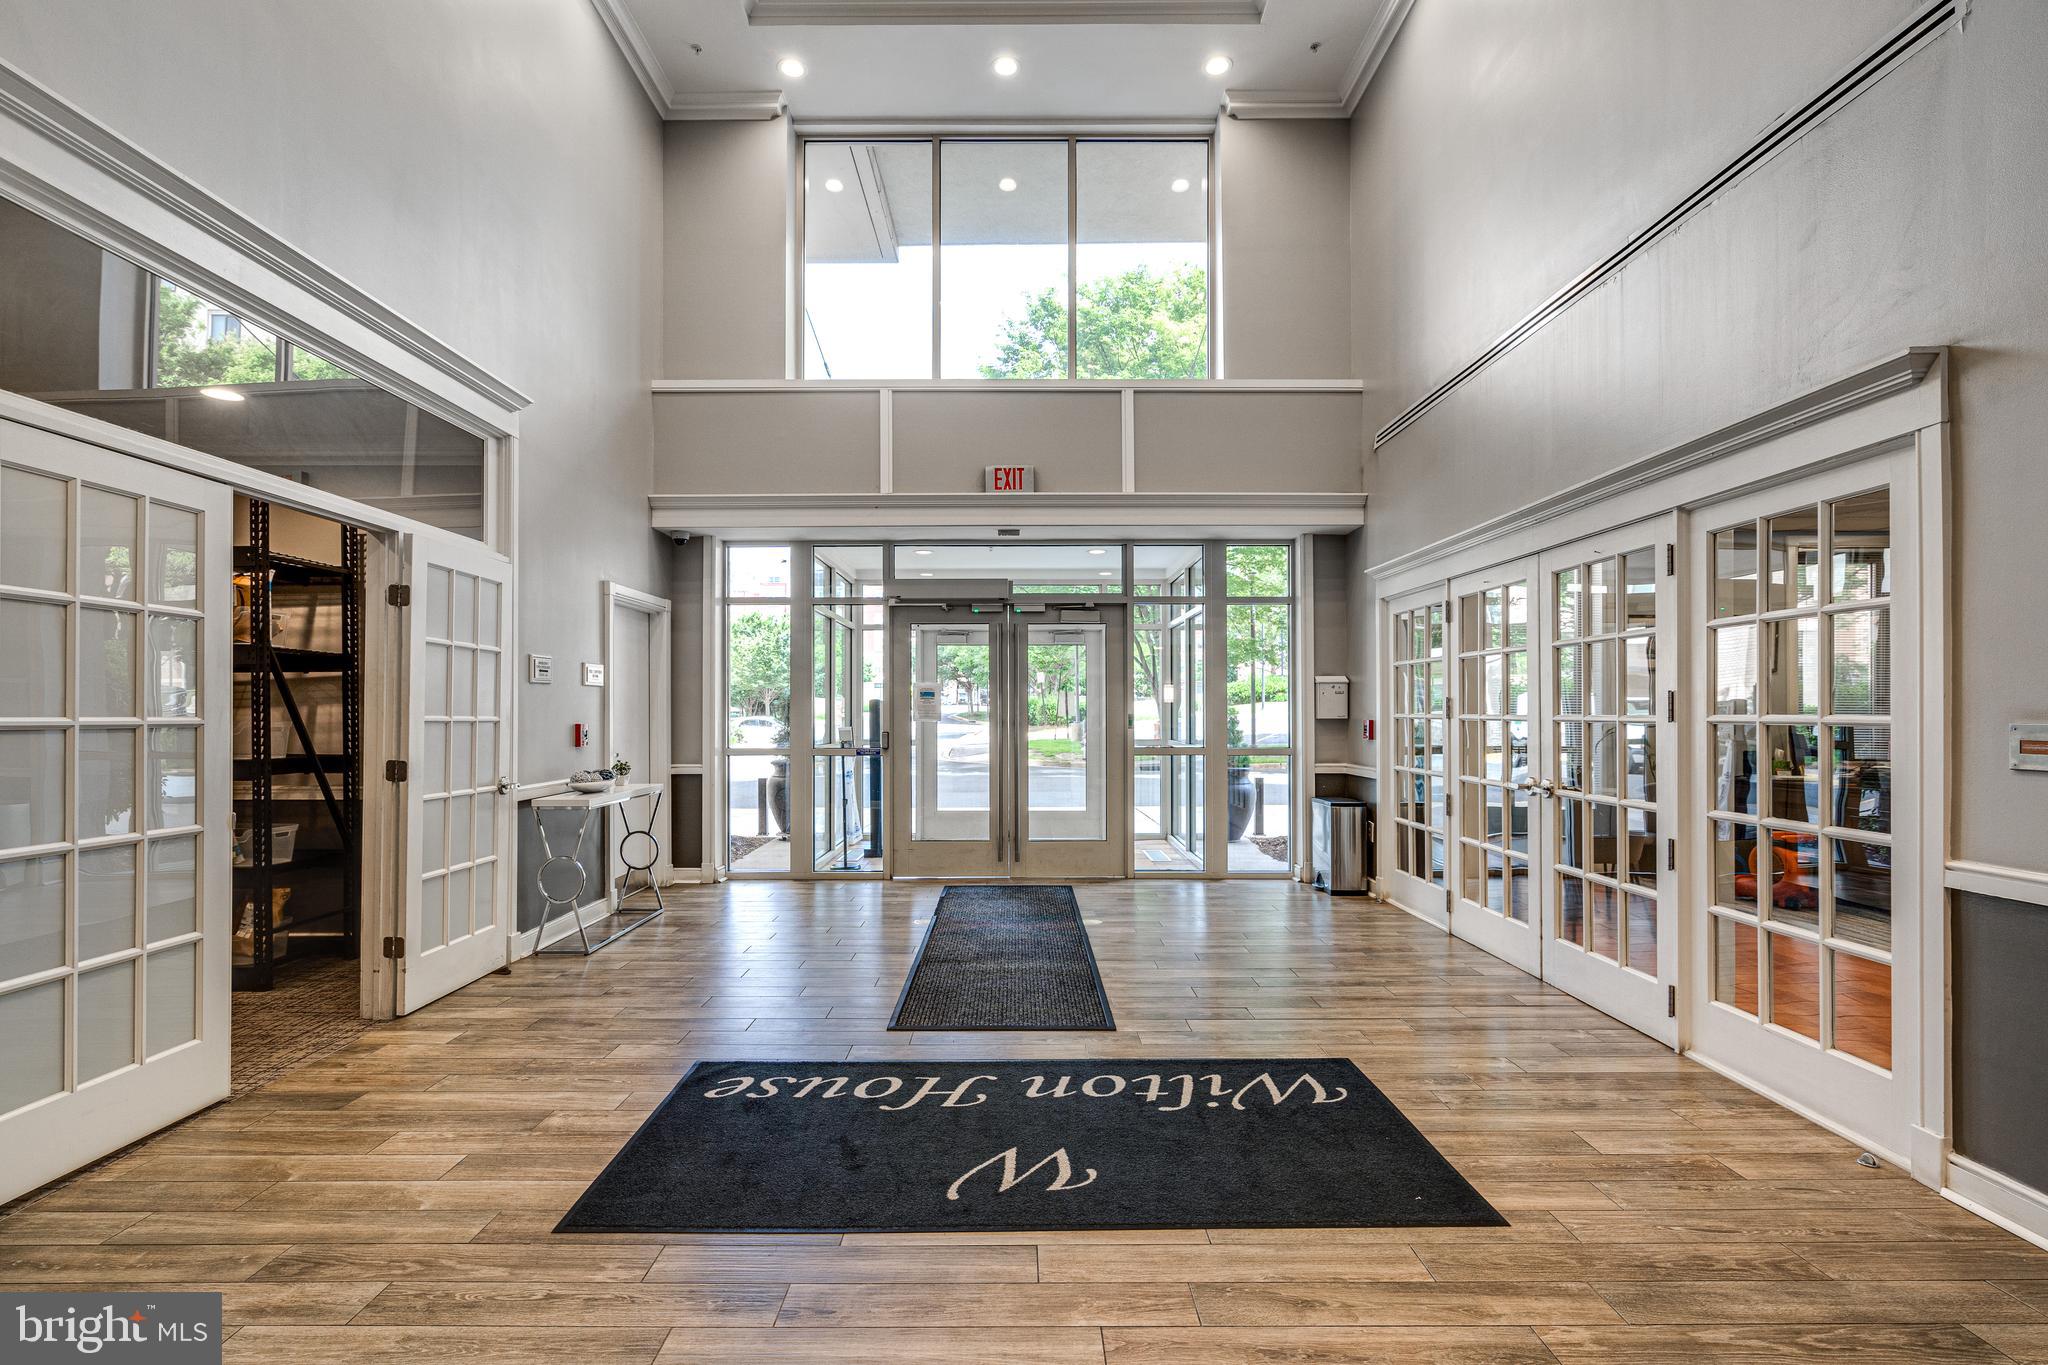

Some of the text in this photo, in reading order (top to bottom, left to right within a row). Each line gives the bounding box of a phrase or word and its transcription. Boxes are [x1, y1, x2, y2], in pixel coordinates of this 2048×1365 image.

[994, 467, 1025, 490] EXIT
[703, 1073, 1348, 1112] Wilton House
[946, 1146, 1098, 1201] W
